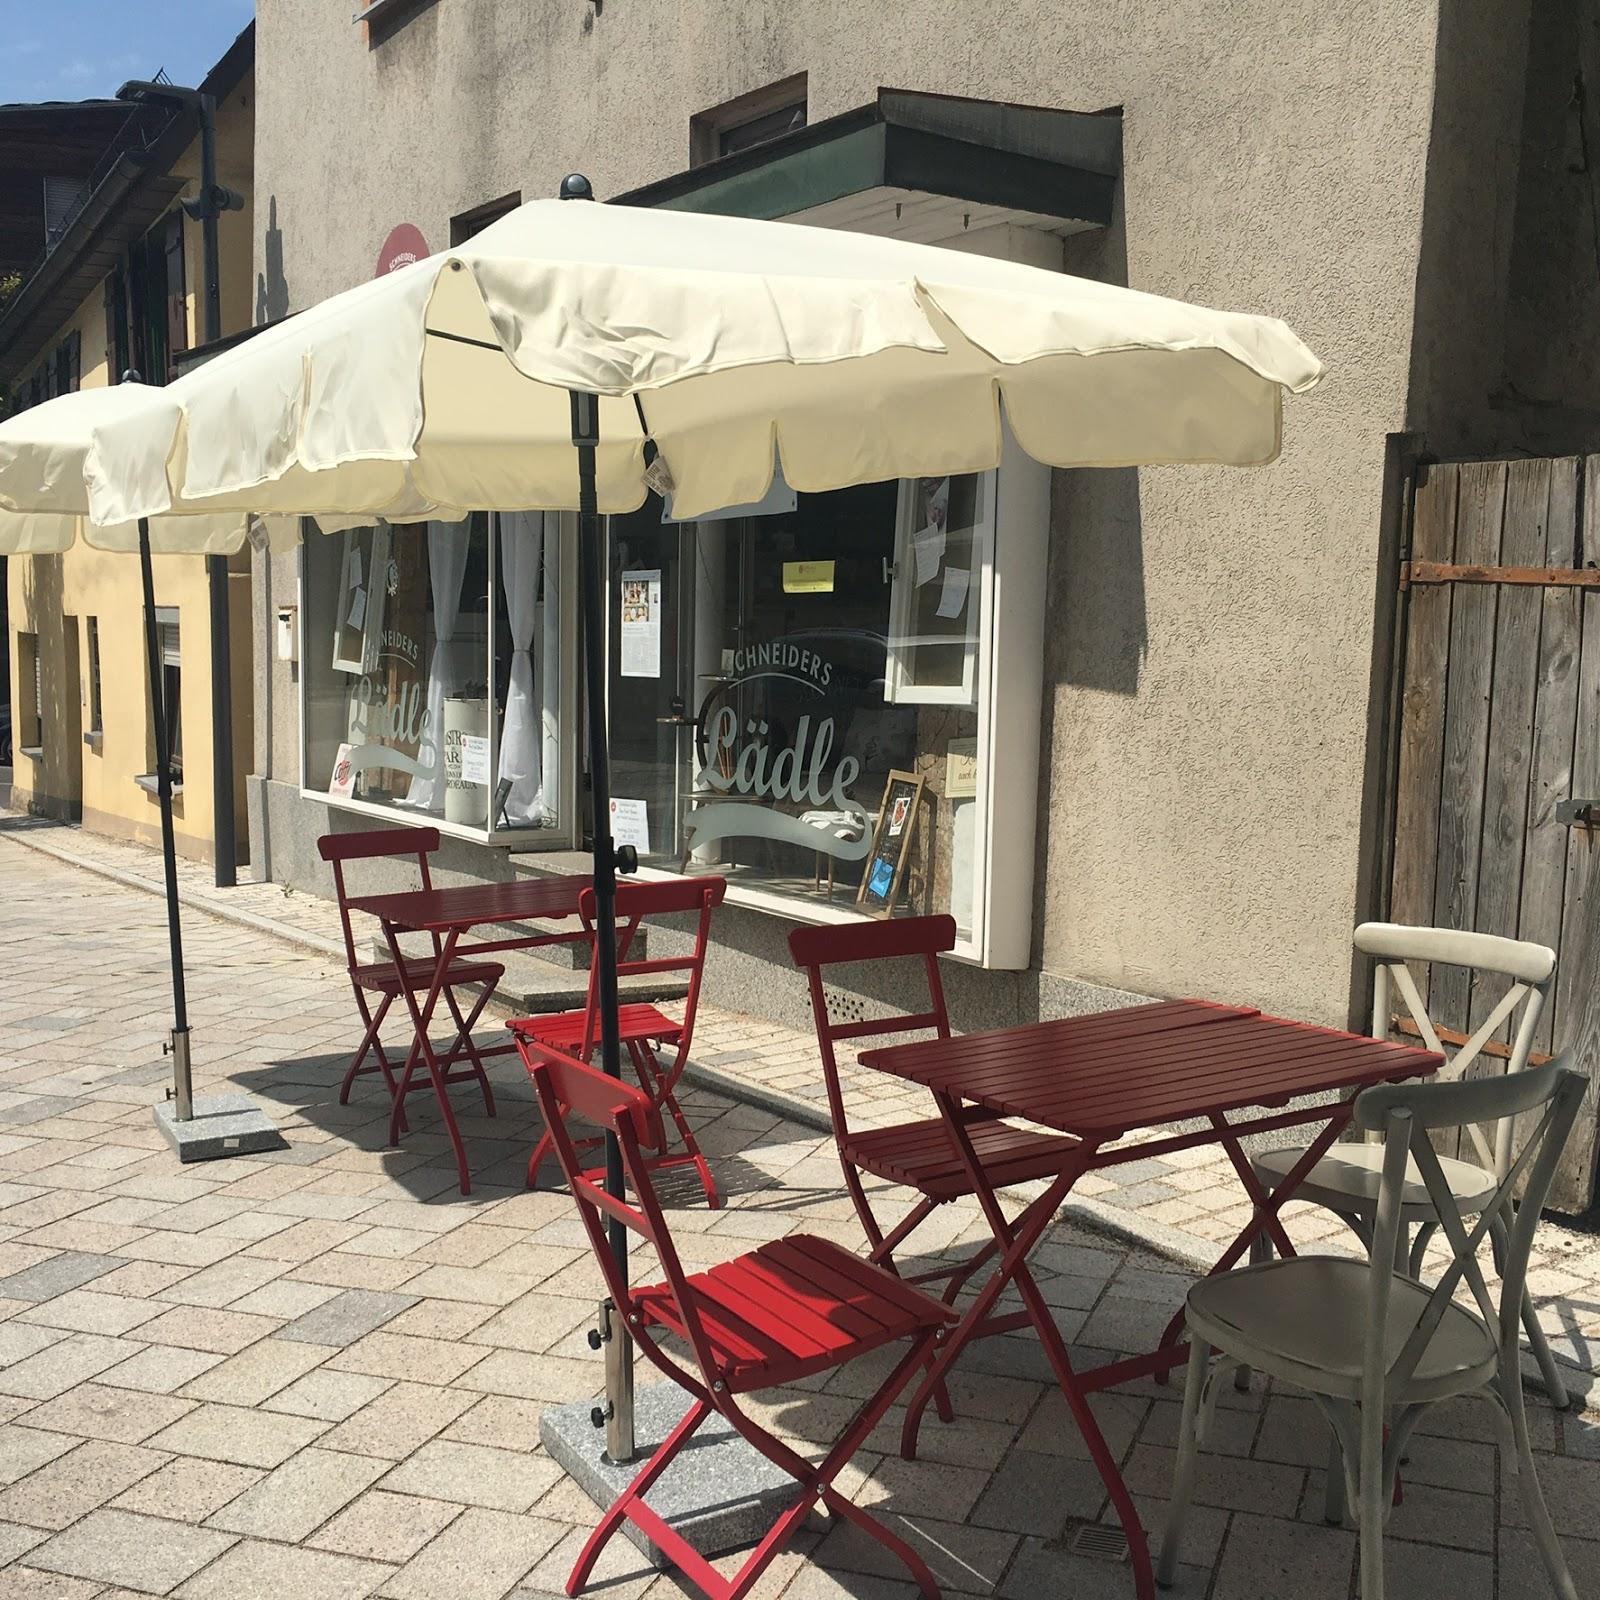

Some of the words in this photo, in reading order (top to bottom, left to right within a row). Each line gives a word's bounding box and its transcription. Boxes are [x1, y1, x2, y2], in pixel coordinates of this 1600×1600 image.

[388, 252, 417, 271] SCHNEIDERS
[381, 630, 419, 661] NEIDERS
[696, 706, 863, 808] Lädle
